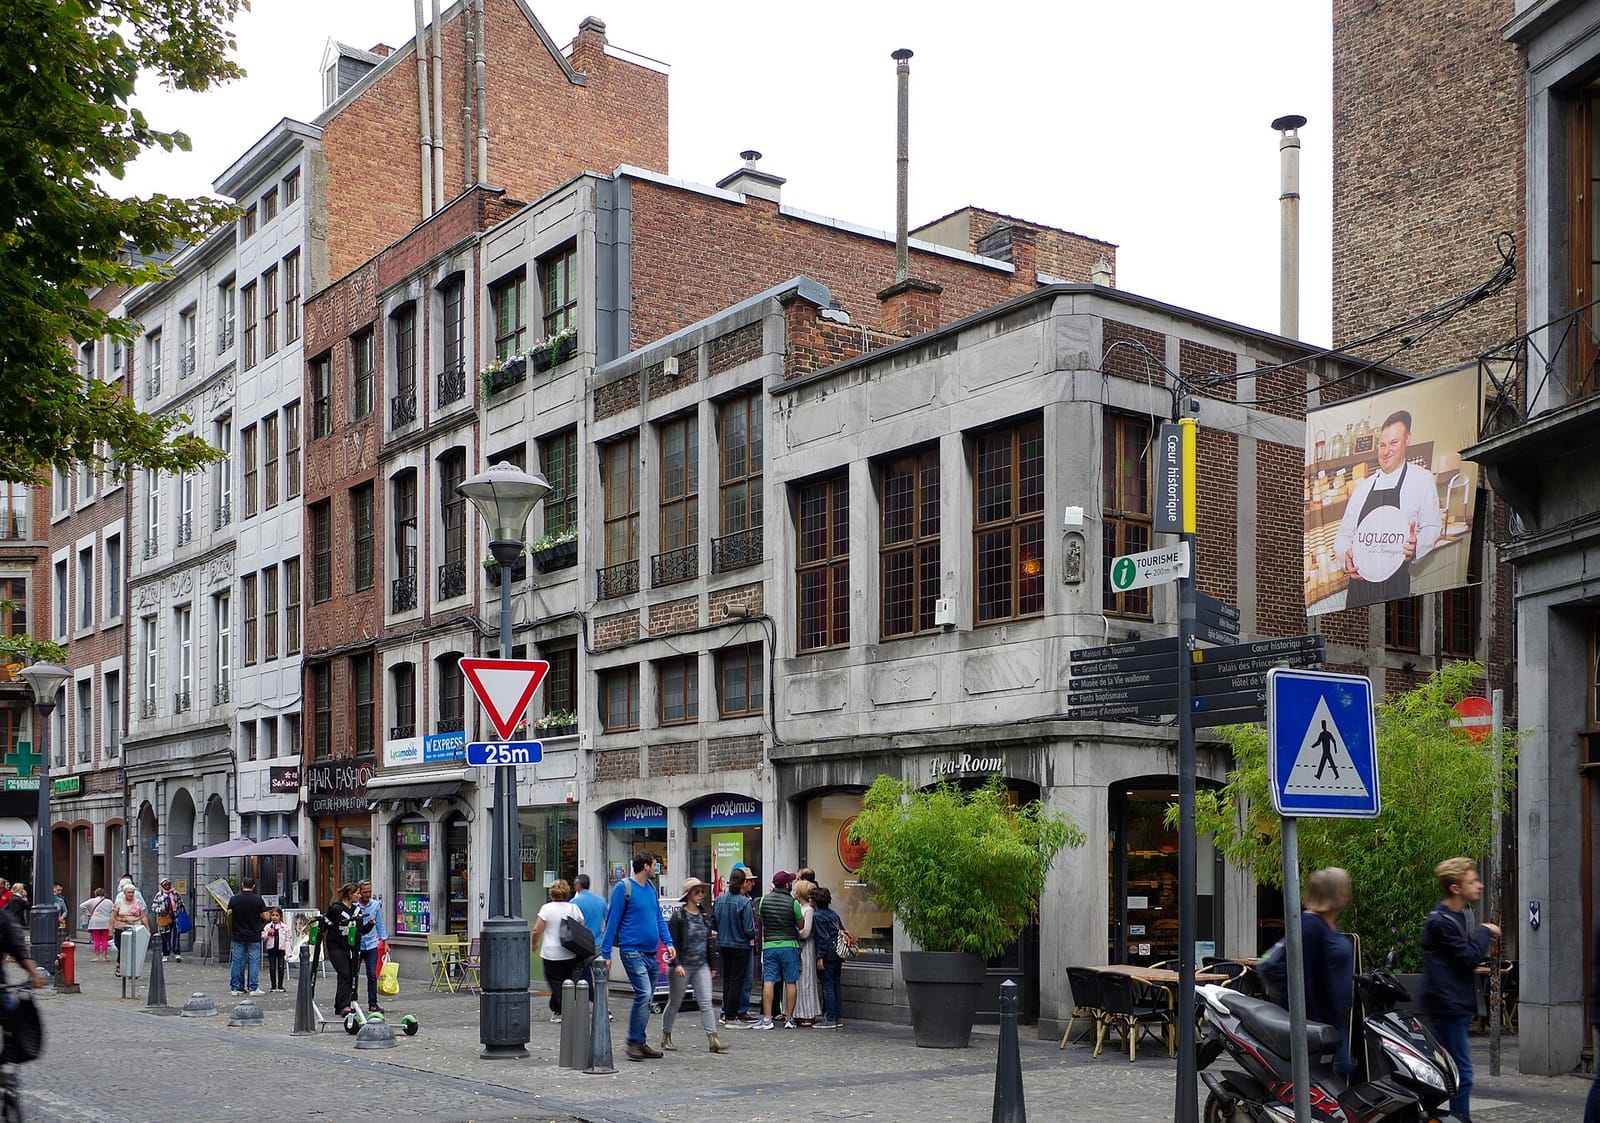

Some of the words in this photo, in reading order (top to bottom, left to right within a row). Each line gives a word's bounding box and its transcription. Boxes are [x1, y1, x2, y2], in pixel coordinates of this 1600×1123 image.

[1167, 435, 1179, 464] Cœur
[1166, 467, 1180, 522] historique
[1358, 532, 1405, 546] uguzon
[1137, 552, 1179, 568] TOURISME
[1153, 568, 1164, 577] 200
[1082, 650, 1102, 658] Maison
[1111, 646, 1136, 654] Tourisme
[1252, 642, 1270, 654] Cœur
[1270, 638, 1304, 650] historiqu
[1082, 664, 1098, 673] Grand
[1098, 662, 1118, 672] Curtius
[1218, 662, 1238, 673] Palais
[1238, 661, 1250, 671] des
[1080, 678, 1098, 688] Musée
[1100, 678, 1106, 686] de
[1108, 677, 1114, 685] la
[1114, 676, 1124, 684] Vie
[1124, 674, 1150, 683] wallonne
[1232, 676, 1249, 688] Hôtel
[1250, 676, 1258, 686] de
[1080, 694, 1094, 703] Fonts
[1096, 691, 1128, 702] baptismaux
[1080, 708, 1098, 717] Musée
[390, 747, 418, 760] Lycamobile
[484, 744, 530, 764] 25m
[930, 754, 1002, 777] Tea-Room
[308, 767, 334, 794] HAIR
[335, 764, 375, 790] FASHION
[624, 804, 663, 820] proximus
[710, 800, 756, 819] proximus
